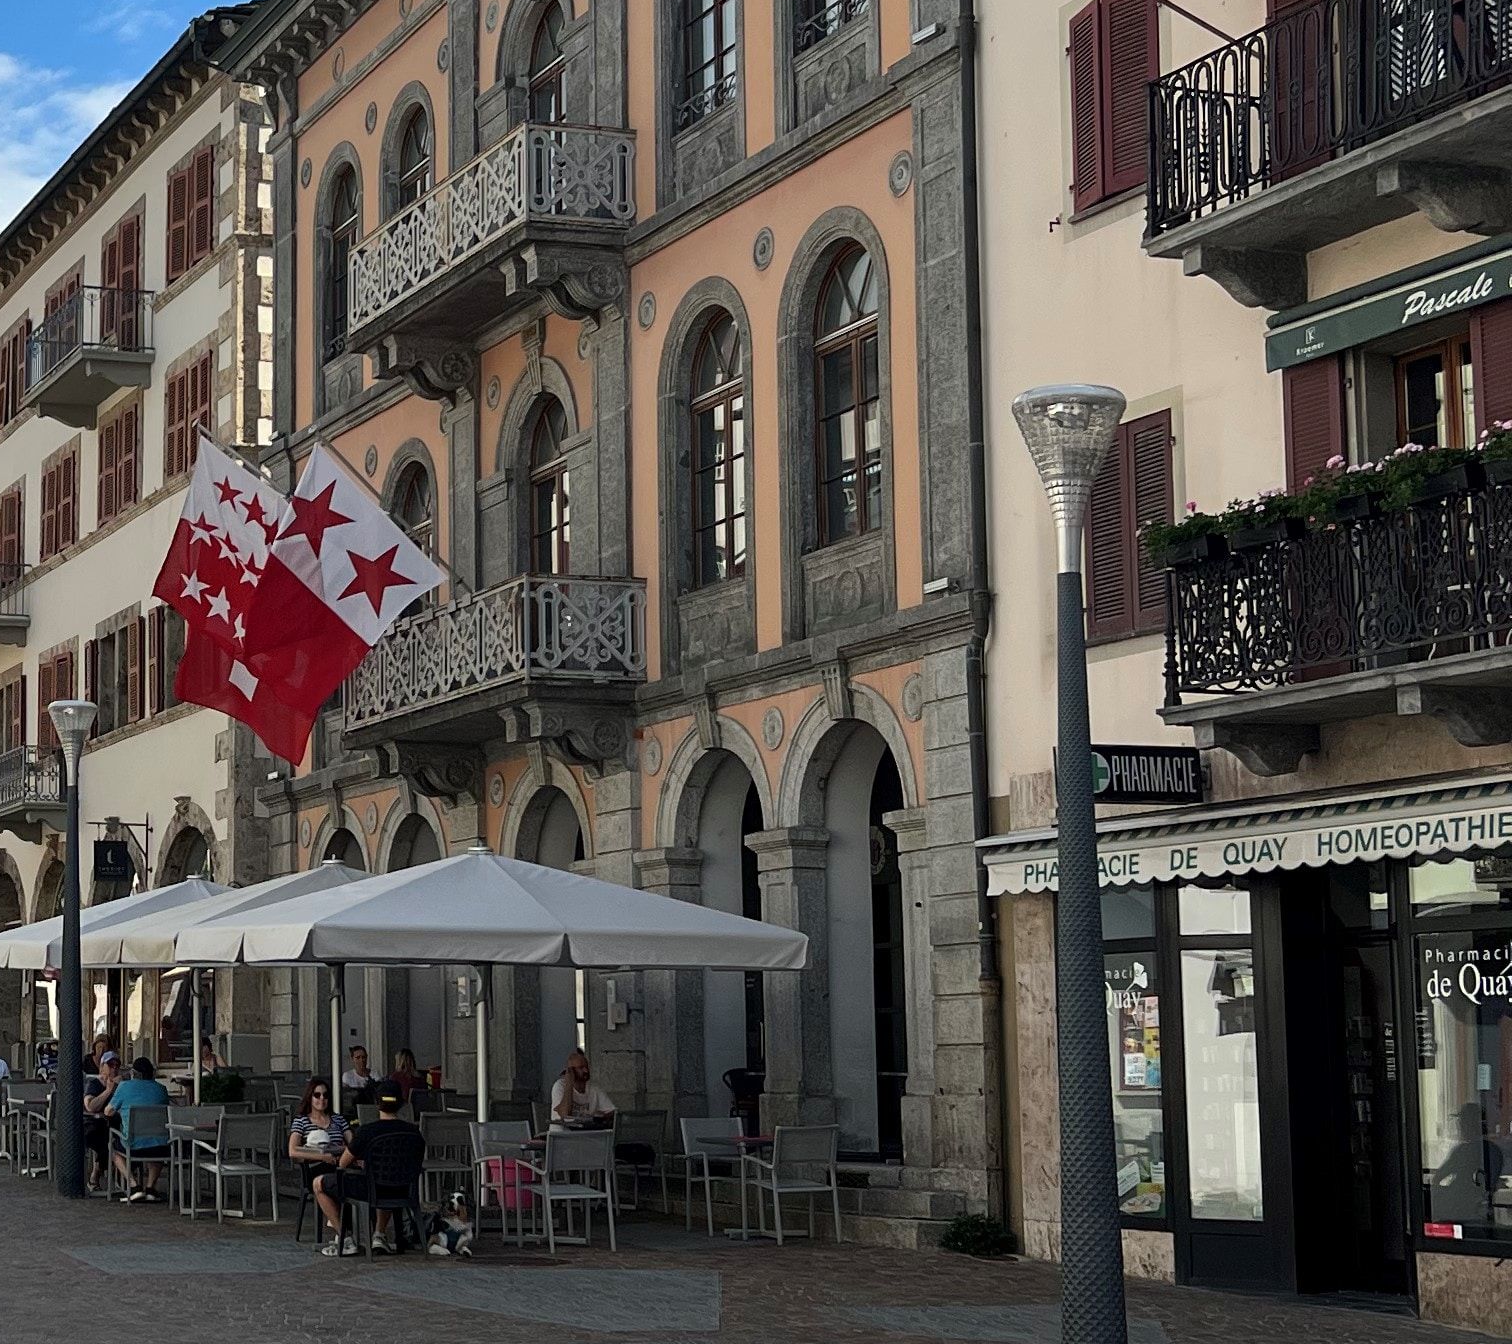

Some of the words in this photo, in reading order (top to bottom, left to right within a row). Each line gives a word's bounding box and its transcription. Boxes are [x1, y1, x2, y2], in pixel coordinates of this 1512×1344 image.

[1401, 272, 1493, 324] Pascale
[1111, 755, 1197, 793] PHARMACIE
[1024, 854, 1140, 884] PHAACIE
[1170, 847, 1198, 871] DE
[1223, 837, 1287, 865] QUAY
[1317, 812, 1512, 857] HOMEOPATHIE
[1425, 945, 1512, 963] Pharmaci
[1427, 969, 1452, 997] de
